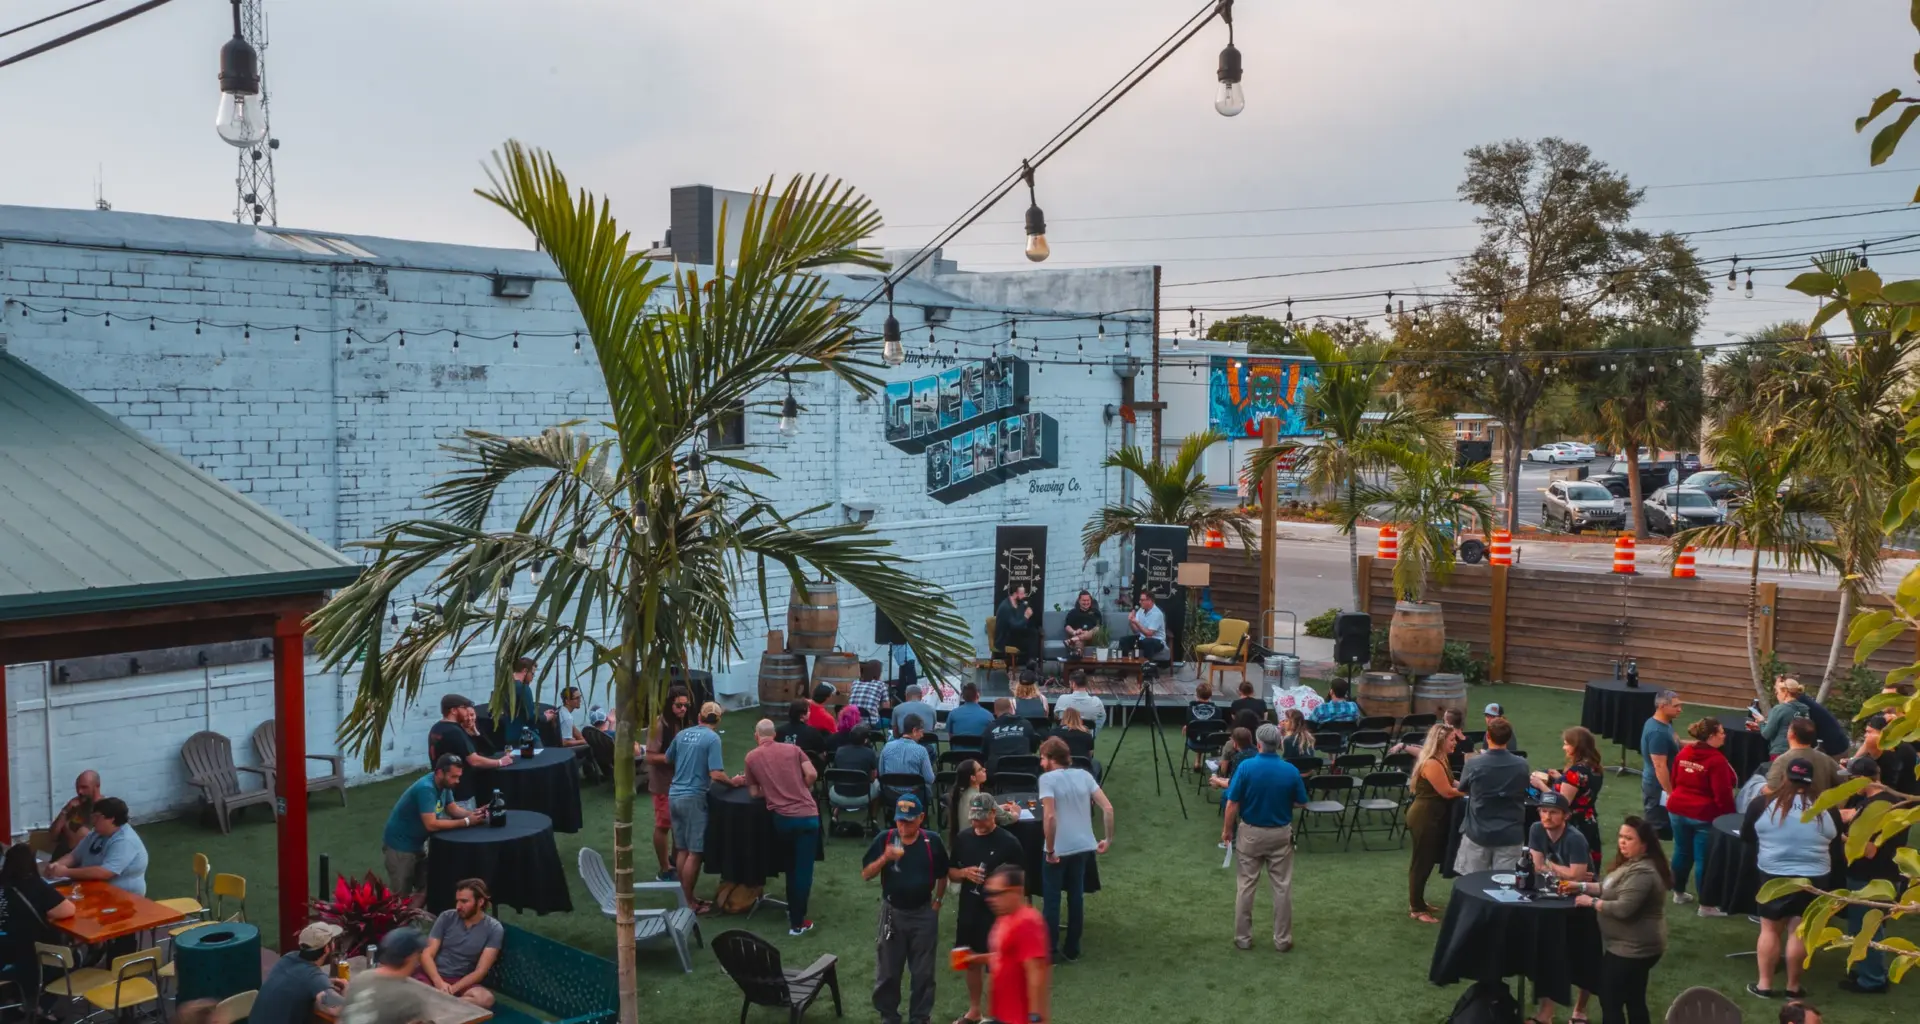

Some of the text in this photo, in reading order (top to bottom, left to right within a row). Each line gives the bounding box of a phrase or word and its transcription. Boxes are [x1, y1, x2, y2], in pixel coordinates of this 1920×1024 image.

[931, 349, 956, 368] from
[884, 354, 1015, 443] GREEN
[926, 411, 1042, 495] BENCH
[1029, 477, 1082, 496] Brewing Co.
